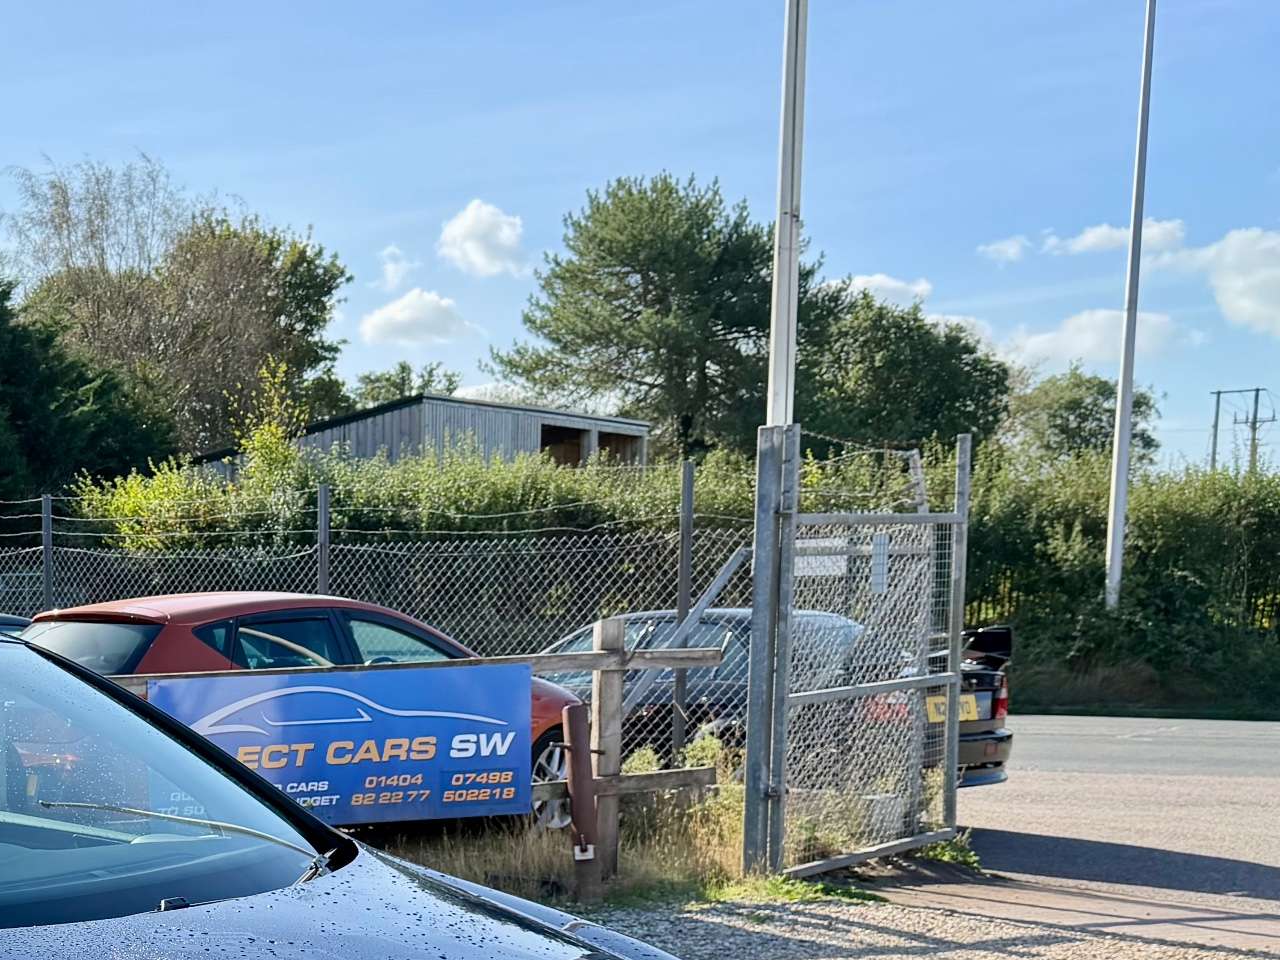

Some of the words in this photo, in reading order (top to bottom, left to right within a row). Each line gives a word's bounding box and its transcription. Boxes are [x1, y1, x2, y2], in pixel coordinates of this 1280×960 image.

[237, 743, 315, 769] ECT
[325, 736, 437, 765] CARS
[449, 731, 517, 758] SW
[364, 773, 424, 789] 01404
[451, 771, 514, 786] 07498
[286, 780, 329, 793] CARS
[297, 795, 341, 807] DGET
[351, 793, 376, 806] 82
[378, 791, 404, 804] 22
[405, 790, 432, 802] 77
[442, 787, 516, 803] 502218
[183, 805, 207, 817] SU
